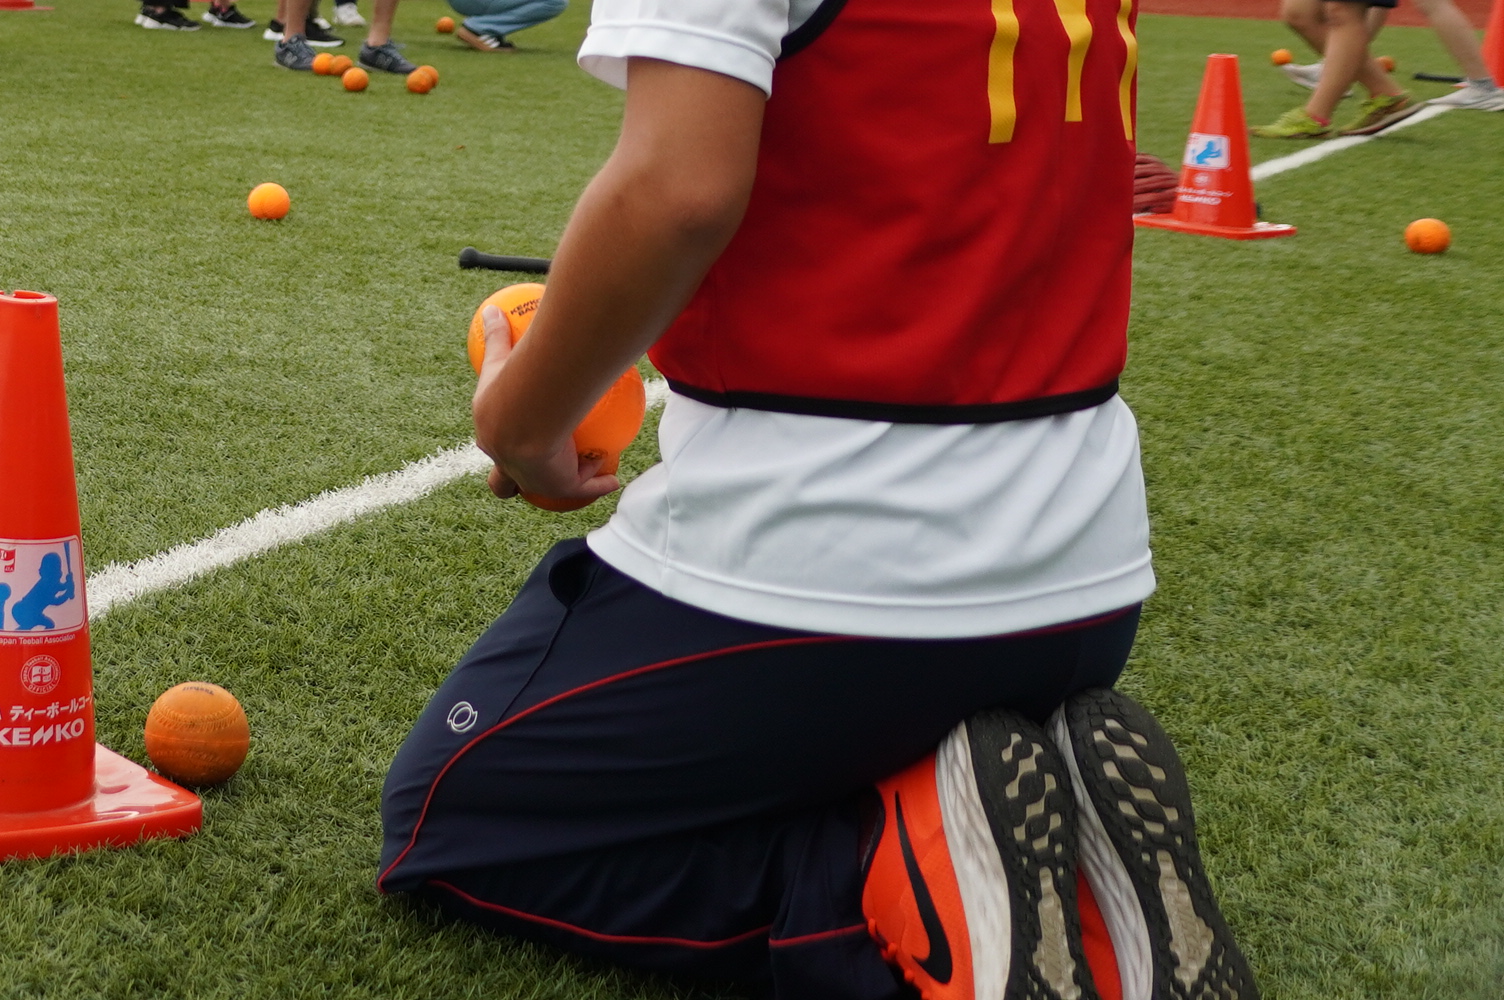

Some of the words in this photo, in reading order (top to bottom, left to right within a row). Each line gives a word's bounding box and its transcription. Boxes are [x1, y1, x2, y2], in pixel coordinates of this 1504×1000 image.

[19, 636, 43, 645] Teeball
[44, 633, 76, 644] Association
[28, 682, 56, 692] OFFICIAL
